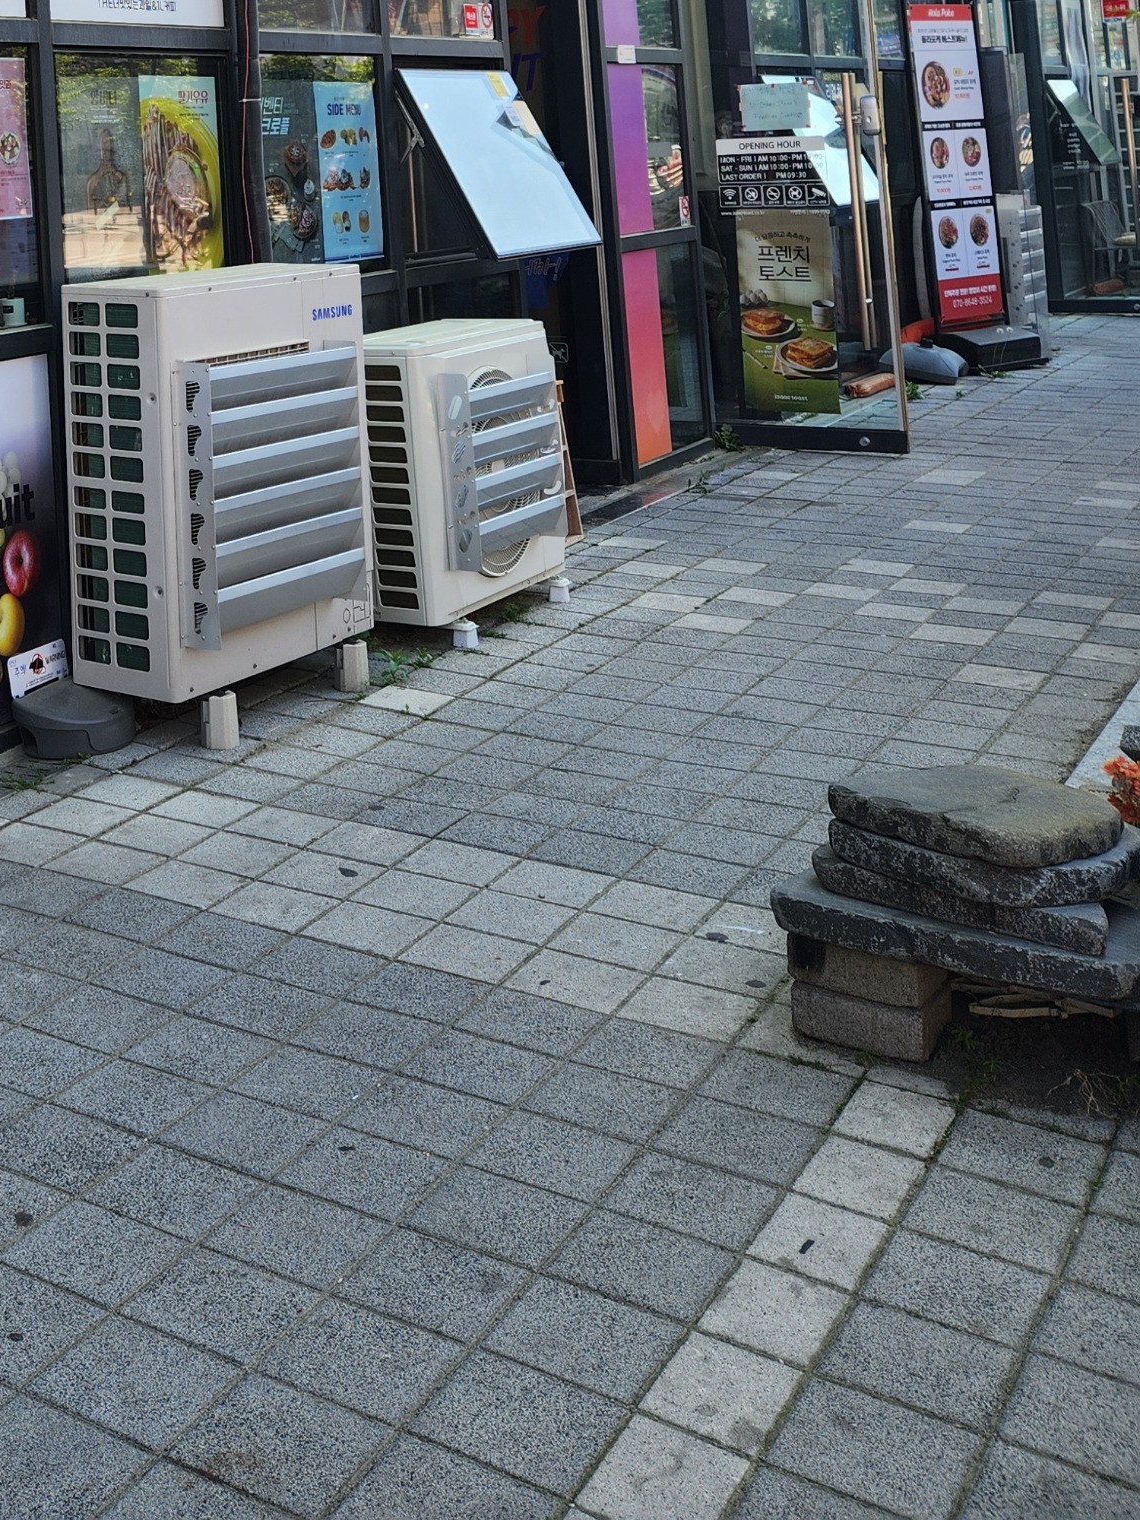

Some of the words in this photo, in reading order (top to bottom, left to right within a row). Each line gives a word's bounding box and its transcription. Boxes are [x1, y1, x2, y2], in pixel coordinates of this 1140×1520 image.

[177, 90, 209, 104] 딸기우유
[326, 103, 345, 116] SIDE
[346, 102, 362, 116] MENU
[261, 117, 290, 136] 크로플
[738, 141, 775, 151] OPENING
[776, 140, 801, 149] HOUR
[720, 156, 736, 164] MON
[740, 155, 752, 163] FRI
[791, 153, 803, 161] PM
[739, 164, 752, 172] SUN
[792, 162, 803, 170] PM
[721, 173, 738, 181] LAST
[738, 172, 763, 181] ORDER
[775, 172, 787, 180] PM
[787, 171, 807, 179] 09:30
[757, 245, 810, 264] 프렌치
[758, 265, 812, 282] 토스트
[312, 303, 353, 321] SAMSUNG
[774, 392, 791, 402] isaac
[791, 393, 809, 402] toast
[44, 649, 66, 665] WARNING
